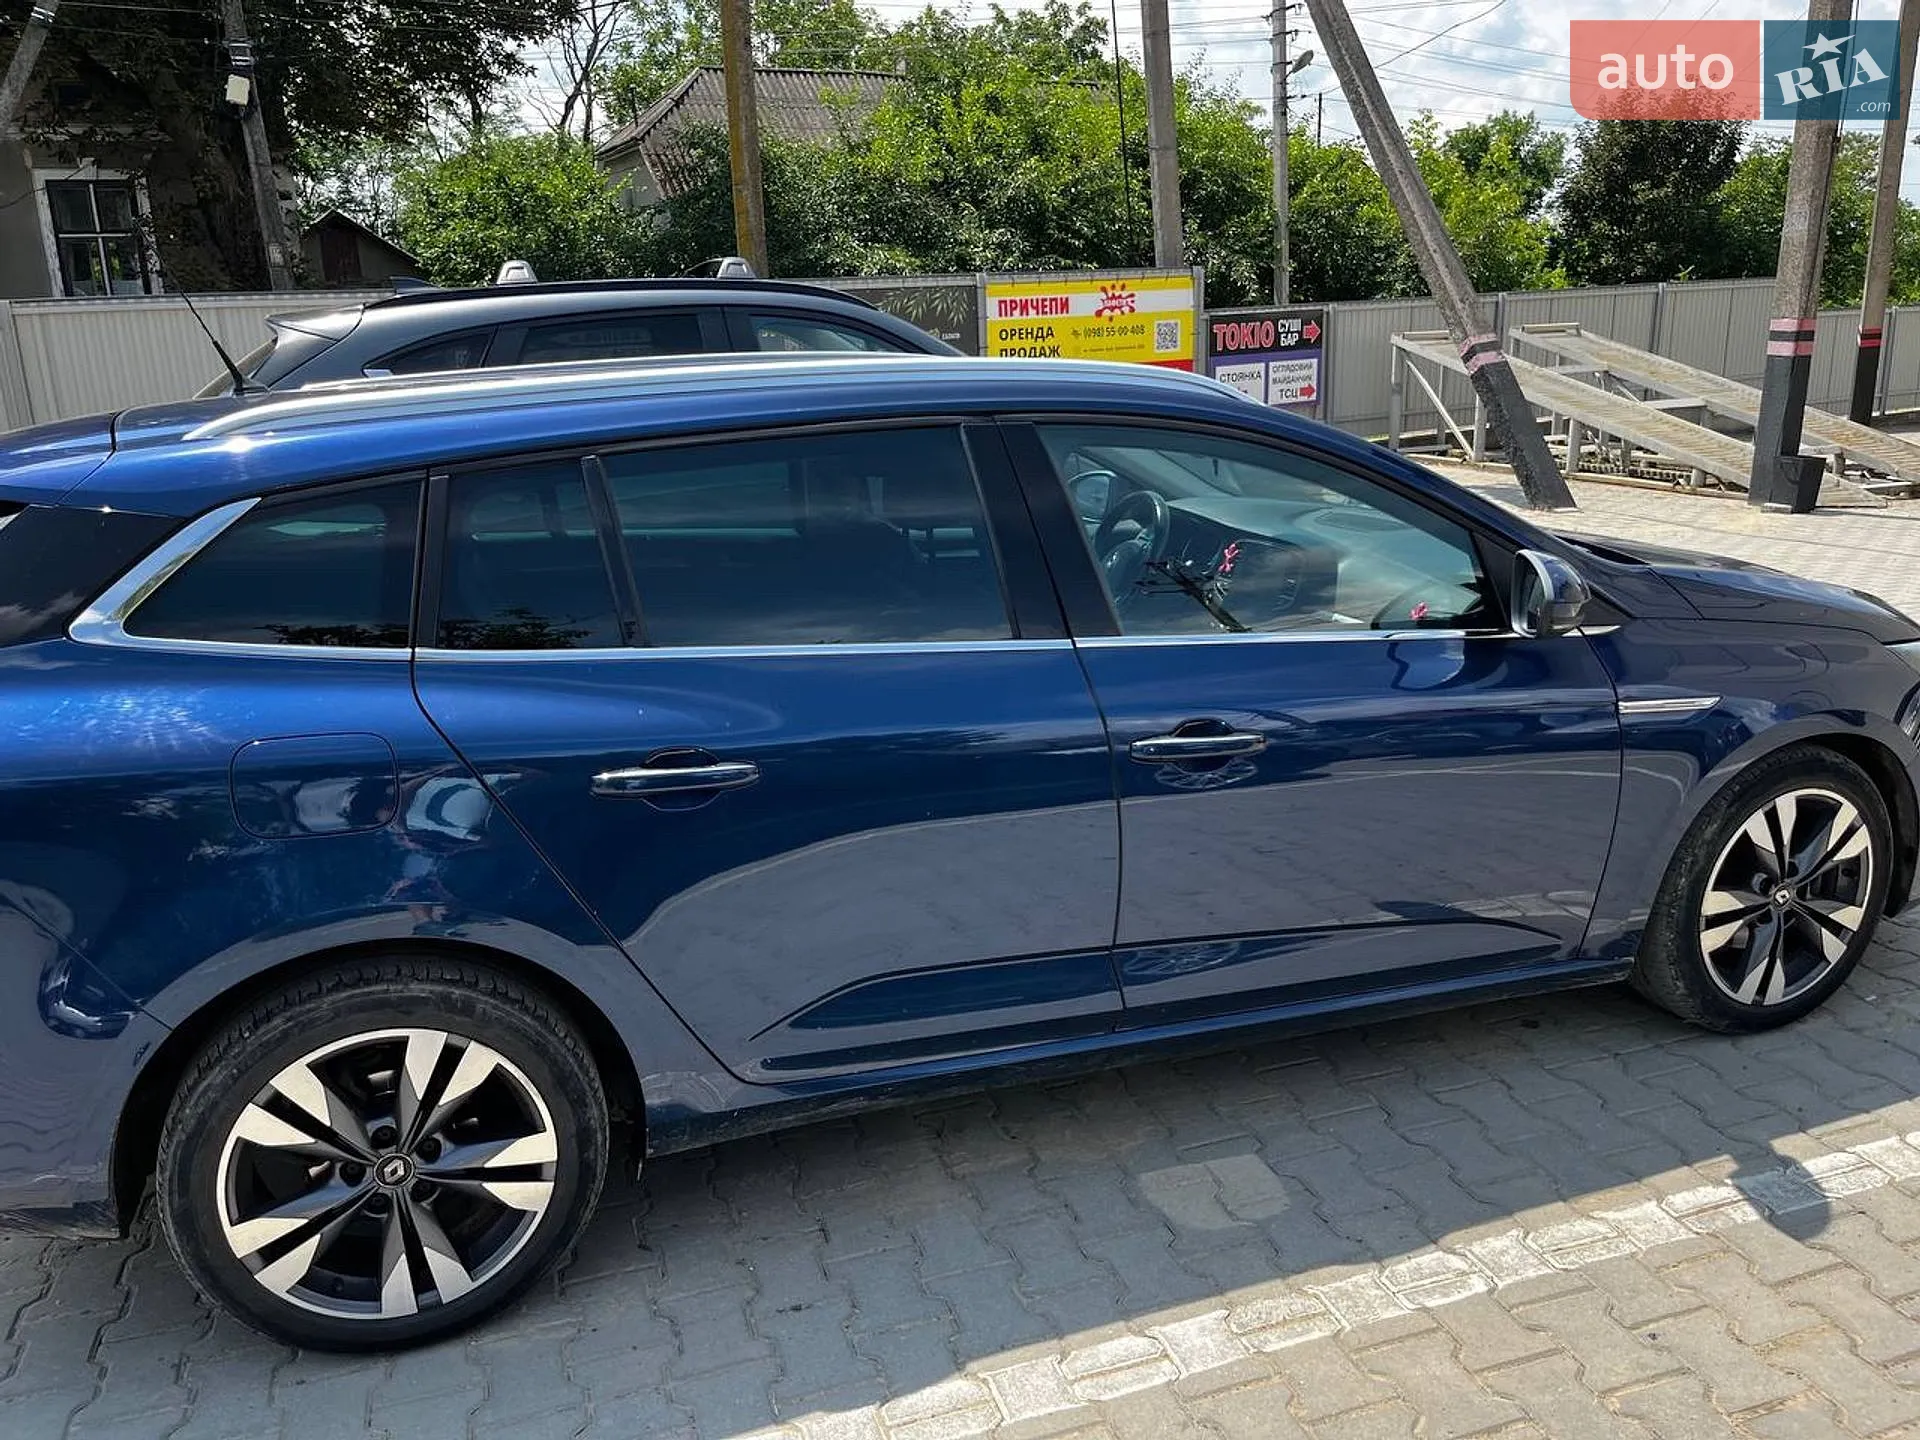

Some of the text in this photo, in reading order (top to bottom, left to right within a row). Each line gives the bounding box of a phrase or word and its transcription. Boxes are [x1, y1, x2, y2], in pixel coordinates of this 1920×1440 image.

[998, 297, 1069, 317] ПРИЧЕПИ
[998, 327, 1055, 342] ОРЕНДА
[1213, 321, 1275, 351] TOKIO
[1280, 333, 1299, 346] БАР
[1000, 345, 1061, 358] ПРОДАЖ
[1219, 370, 1261, 383] СТОЯНКА
[1278, 388, 1298, 399] ТСЦ
